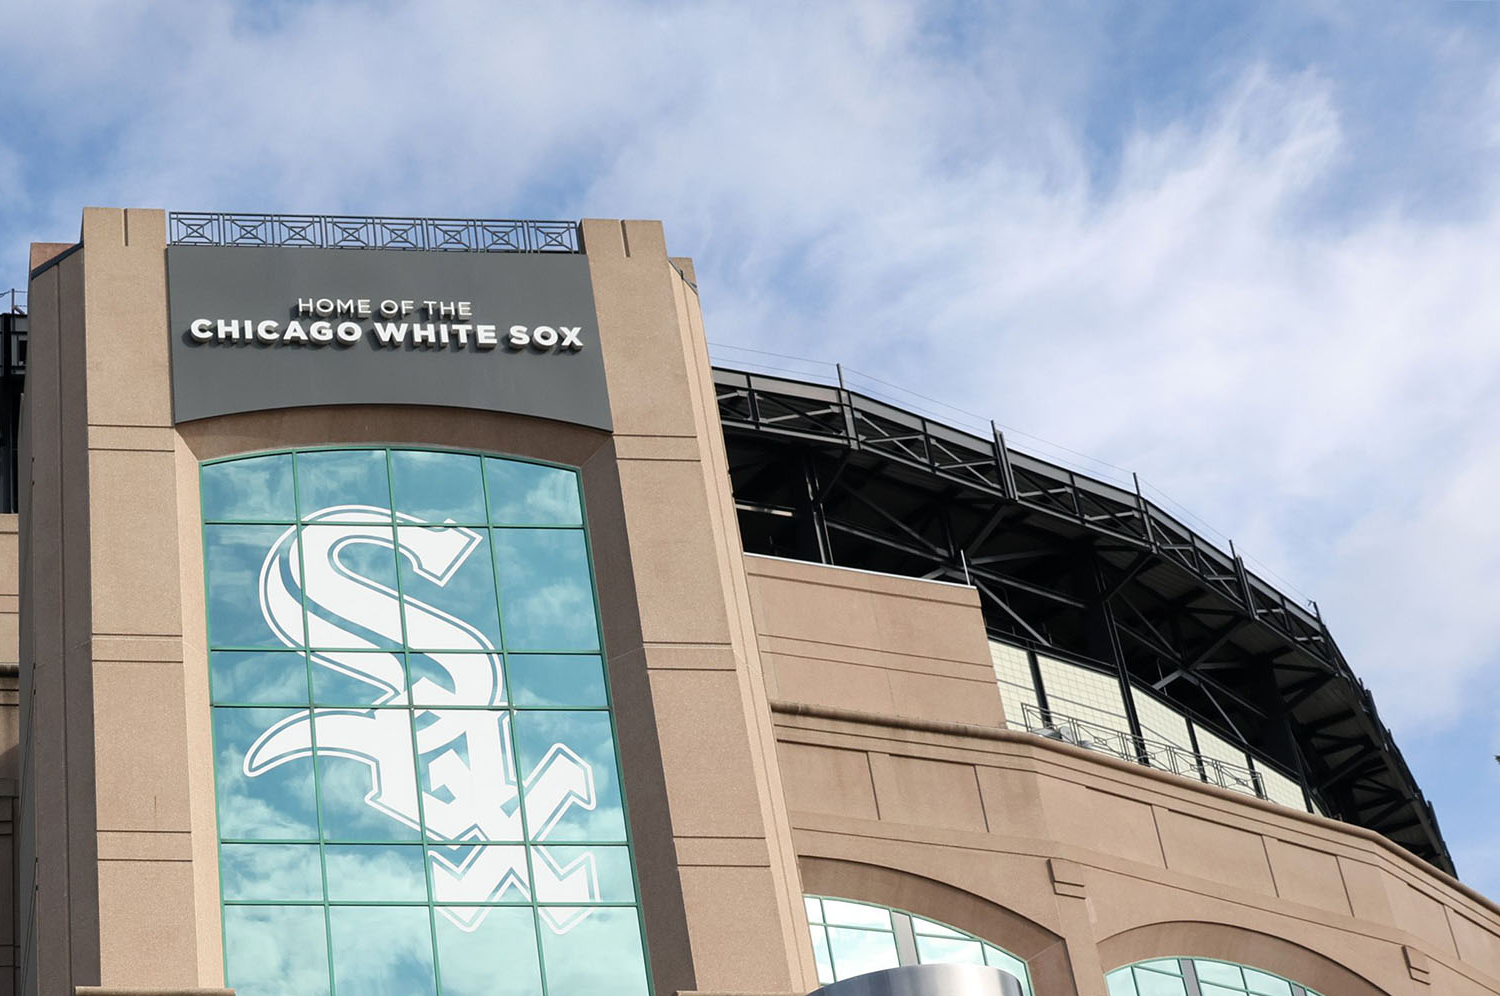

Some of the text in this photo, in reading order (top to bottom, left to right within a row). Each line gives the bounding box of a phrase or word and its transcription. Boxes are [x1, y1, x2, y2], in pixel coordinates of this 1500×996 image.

[298, 298, 472, 319] HOME OF THE
[190, 318, 583, 348] CHICAGO WHITE SOX
